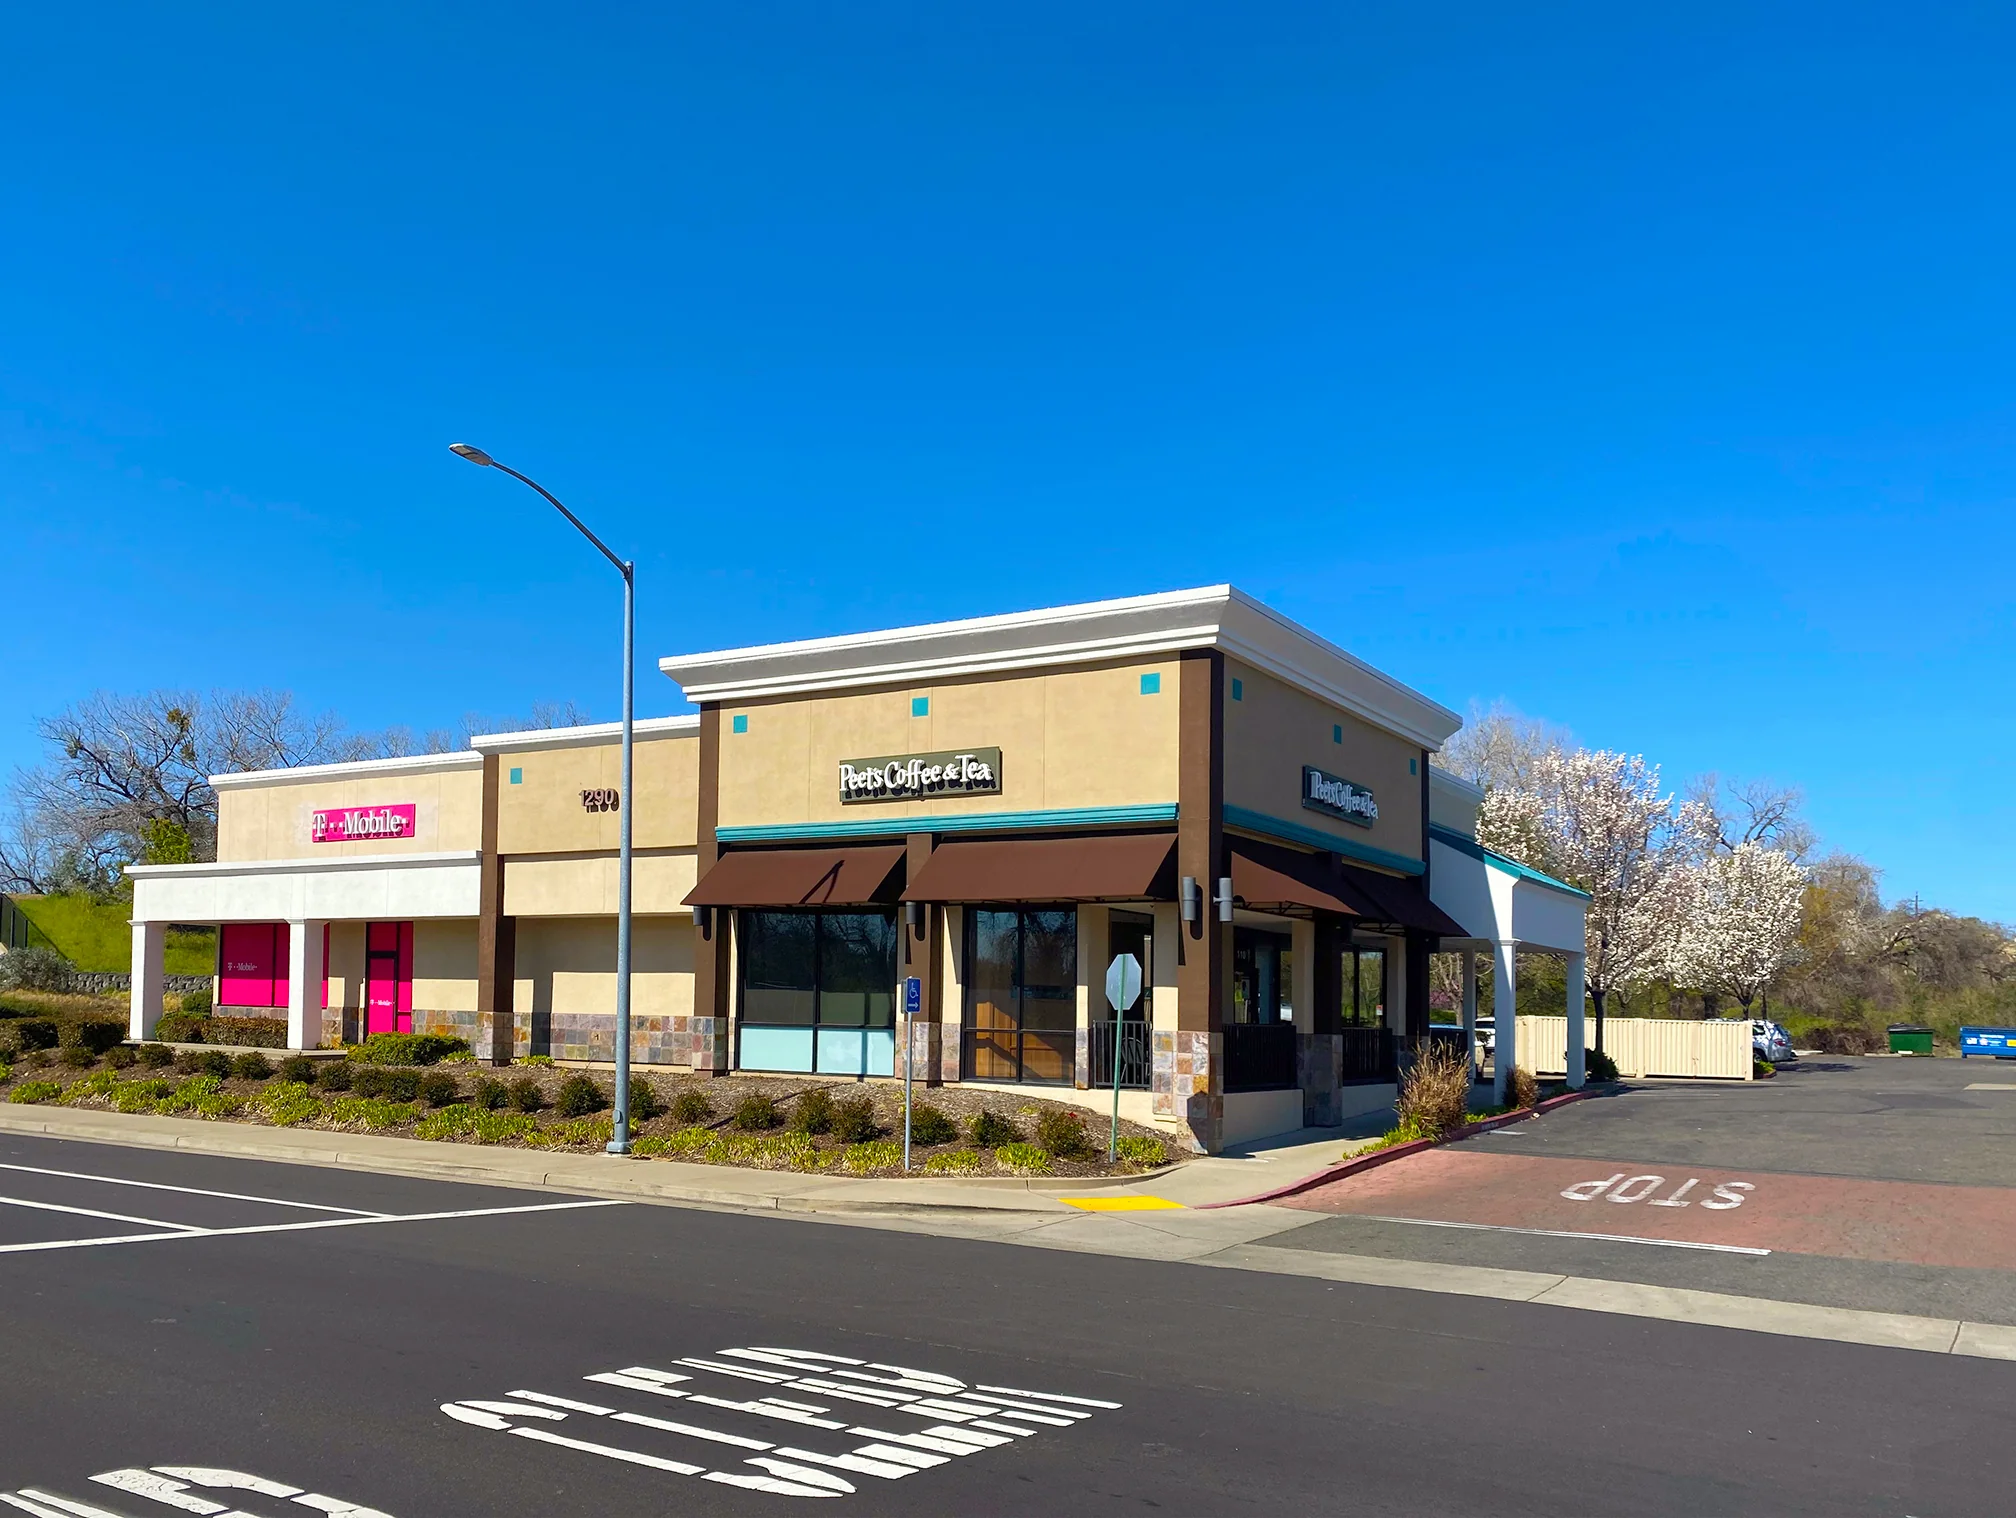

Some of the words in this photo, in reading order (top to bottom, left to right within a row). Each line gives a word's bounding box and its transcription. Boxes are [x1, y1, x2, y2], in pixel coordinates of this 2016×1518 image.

[839, 764, 884, 791] Peet's
[884, 758, 943, 789] Coffee
[942, 763, 960, 782] &
[955, 754, 994, 783] Tea
[579, 788, 615, 806] 1290
[1560, 1173, 1756, 1210] STOP
[440, 1347, 1123, 1498] CLEAR
